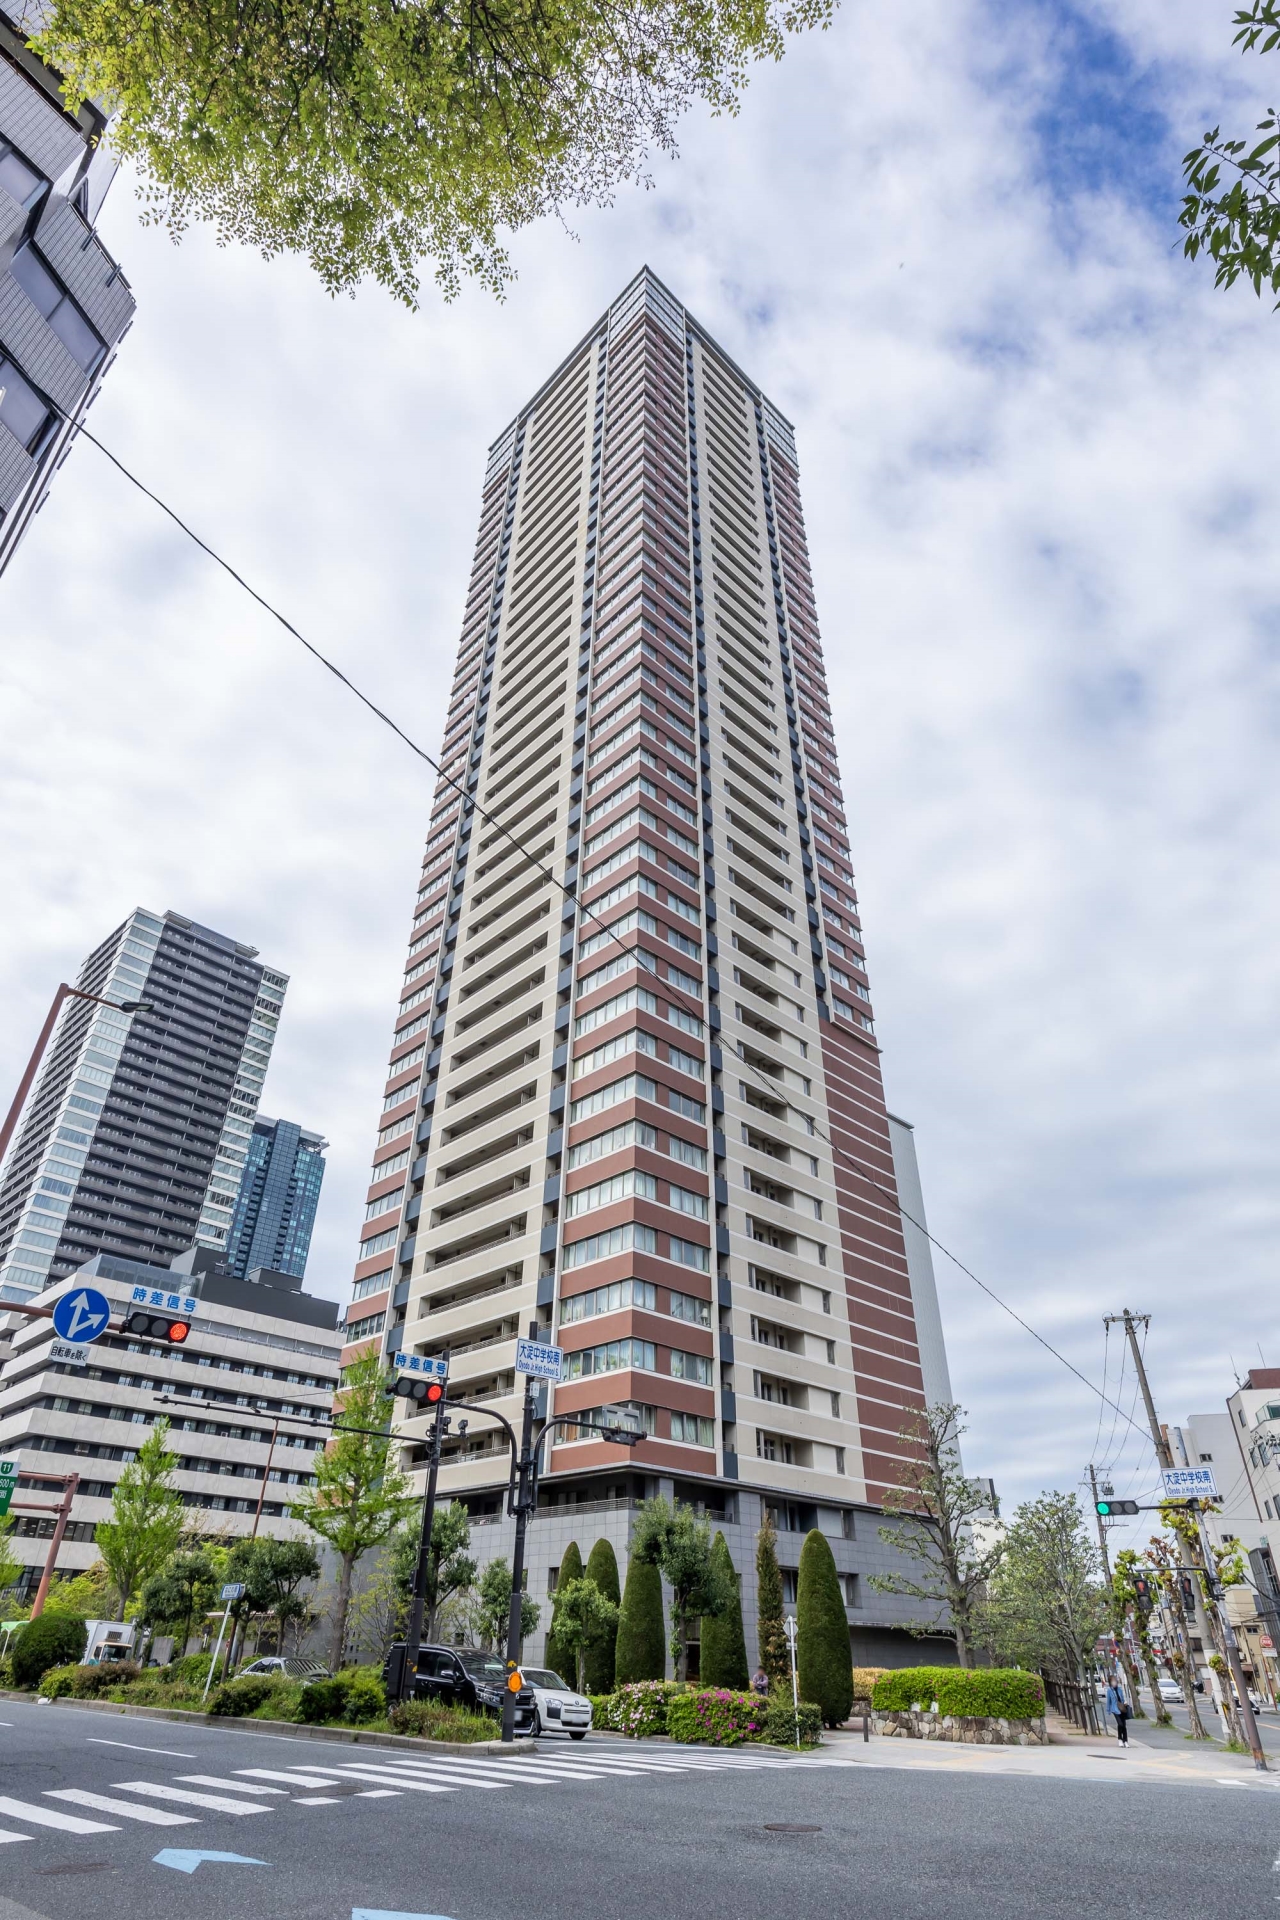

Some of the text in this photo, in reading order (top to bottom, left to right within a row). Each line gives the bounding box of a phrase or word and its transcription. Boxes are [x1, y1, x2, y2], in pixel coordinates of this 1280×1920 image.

[132, 1287, 196, 1313] 時差信号
[51, 1345, 87, 1361] 自転車を除く
[519, 1343, 560, 1366] 大淀中学校南
[395, 1353, 446, 1375] 時差信号
[518, 1359, 530, 1371] Oyodo
[543, 1365, 555, 1376] School
[3, 1463, 11, 1472] 11
[1165, 1470, 1212, 1485] 大淀中学校南
[1195, 1485, 1209, 1493] School
